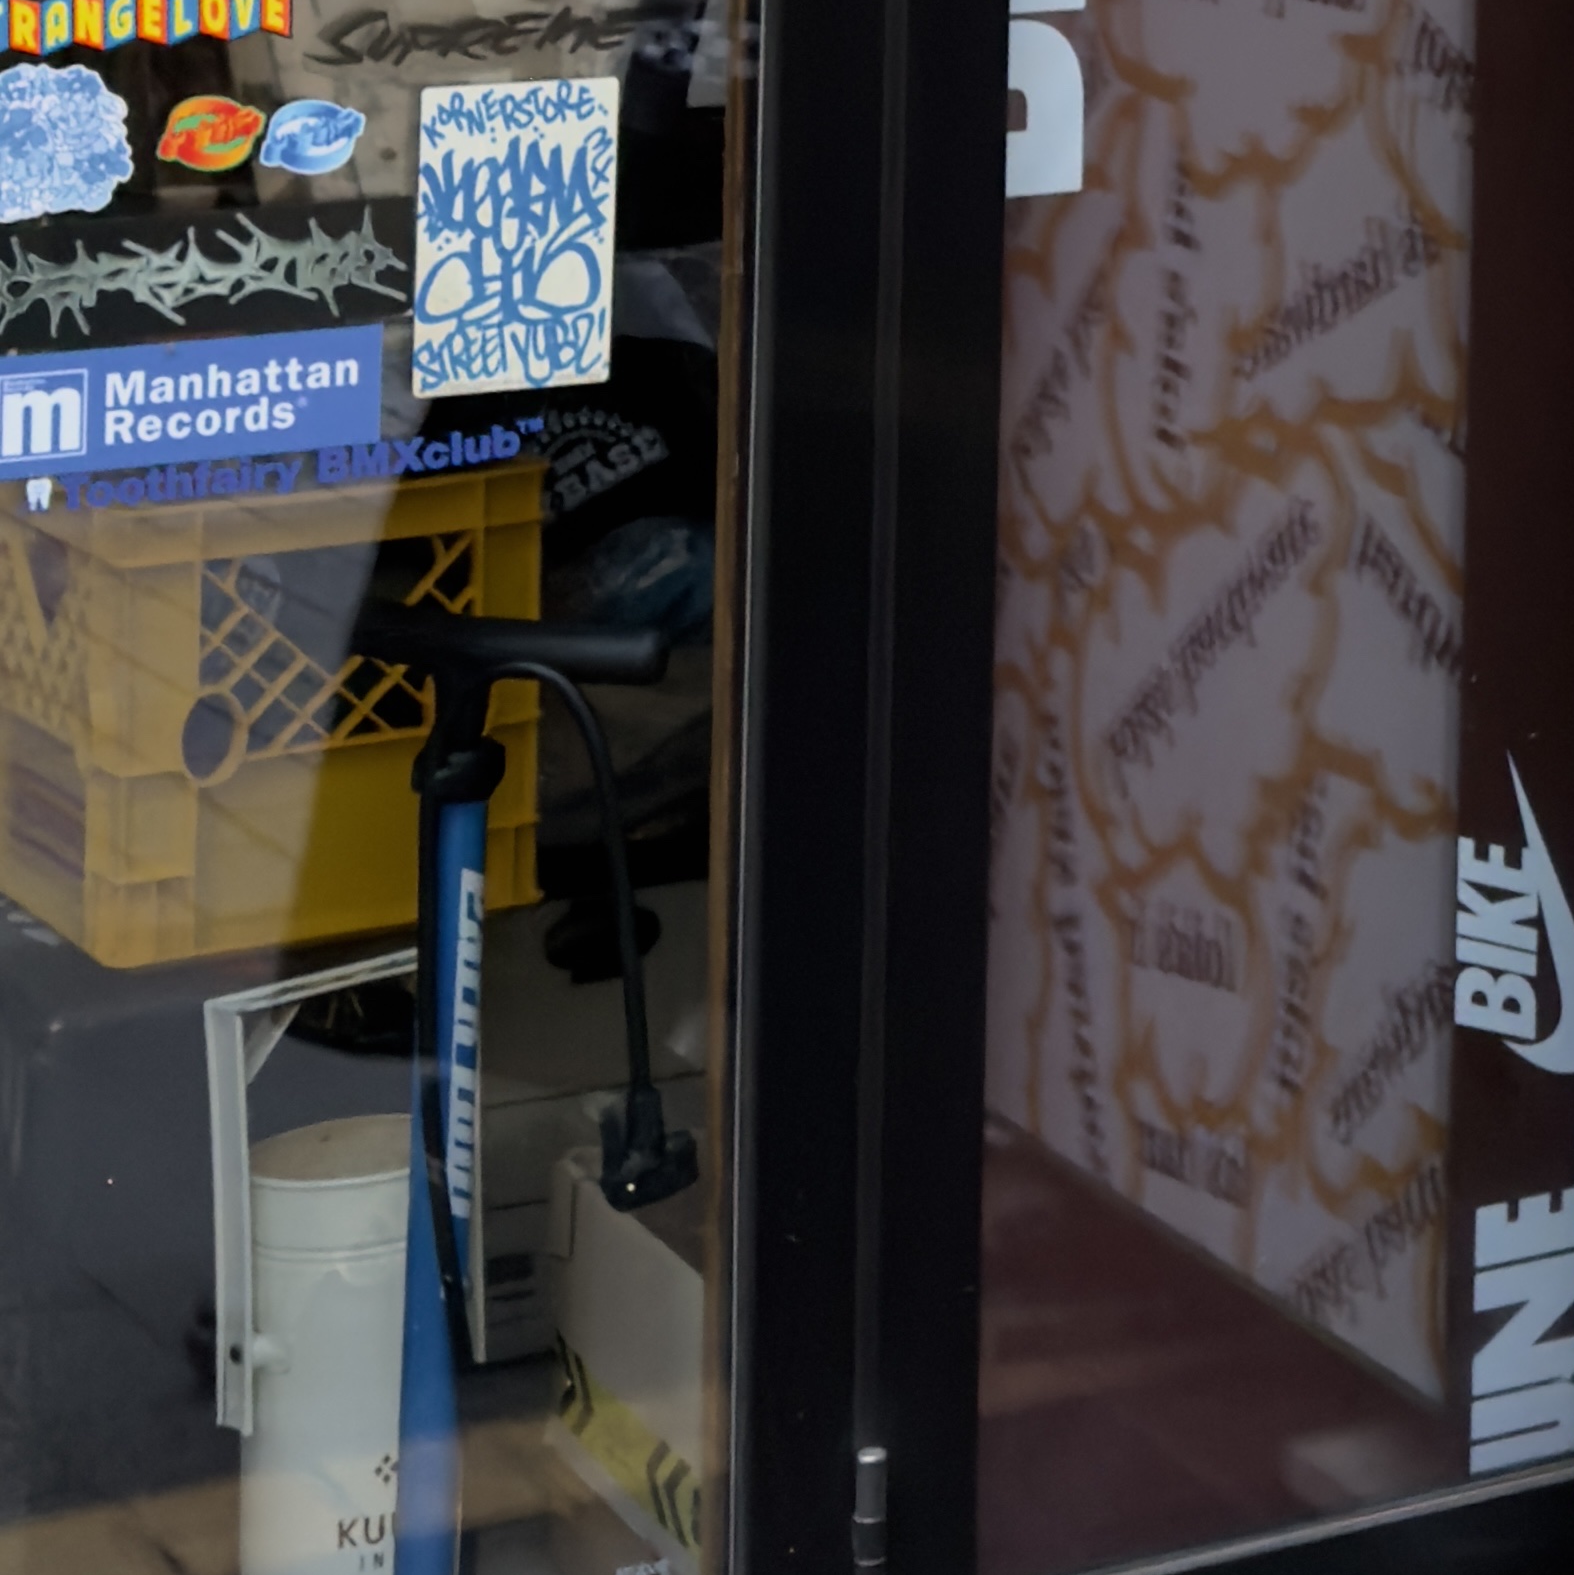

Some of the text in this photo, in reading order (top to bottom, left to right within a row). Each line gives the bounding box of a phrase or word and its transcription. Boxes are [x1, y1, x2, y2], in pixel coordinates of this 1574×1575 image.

[105, 356, 360, 409] Manhattan
[105, 399, 297, 445] Records
[60, 458, 300, 512] Toothfairy
[1454, 834, 1538, 1041] BIKE
